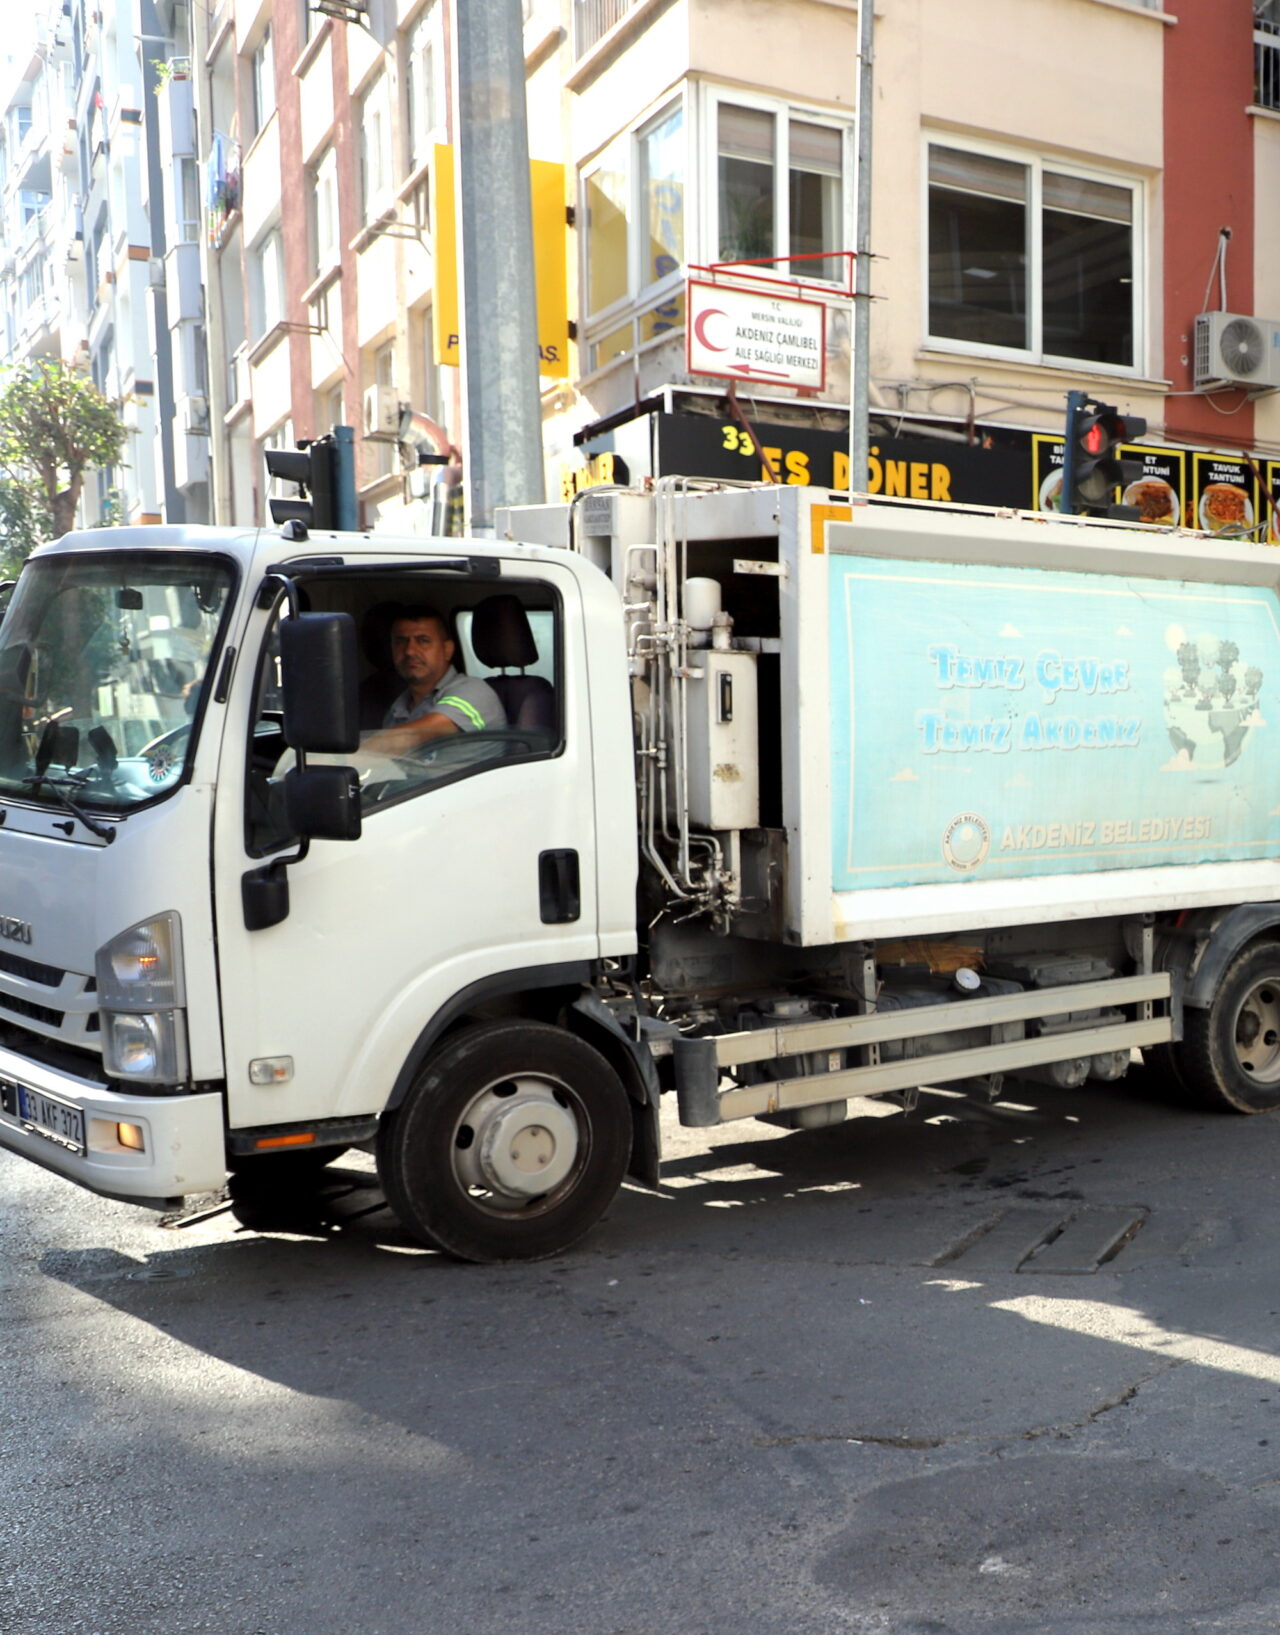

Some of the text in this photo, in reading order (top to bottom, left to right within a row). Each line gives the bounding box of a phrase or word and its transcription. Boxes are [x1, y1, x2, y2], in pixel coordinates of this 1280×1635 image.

[735, 326, 818, 350] AKDENİZ ÇAMLIBEL
[735, 347, 819, 370] AİLE SAĞLIĞI MERKEZİ
[721, 425, 755, 456] 33
[1145, 456, 1158, 464] ET
[1212, 463, 1241, 474] TAVUK
[761, 446, 952, 501] ES DÖNER
[1208, 472, 1245, 484] TANTUNİ
[1000, 816, 1212, 852] AKDENİZ BELEDİYESİ
[26, 1092, 38, 1122] 33
[40, 1099, 59, 1132] AKF
[60, 1109, 82, 1142] 372
